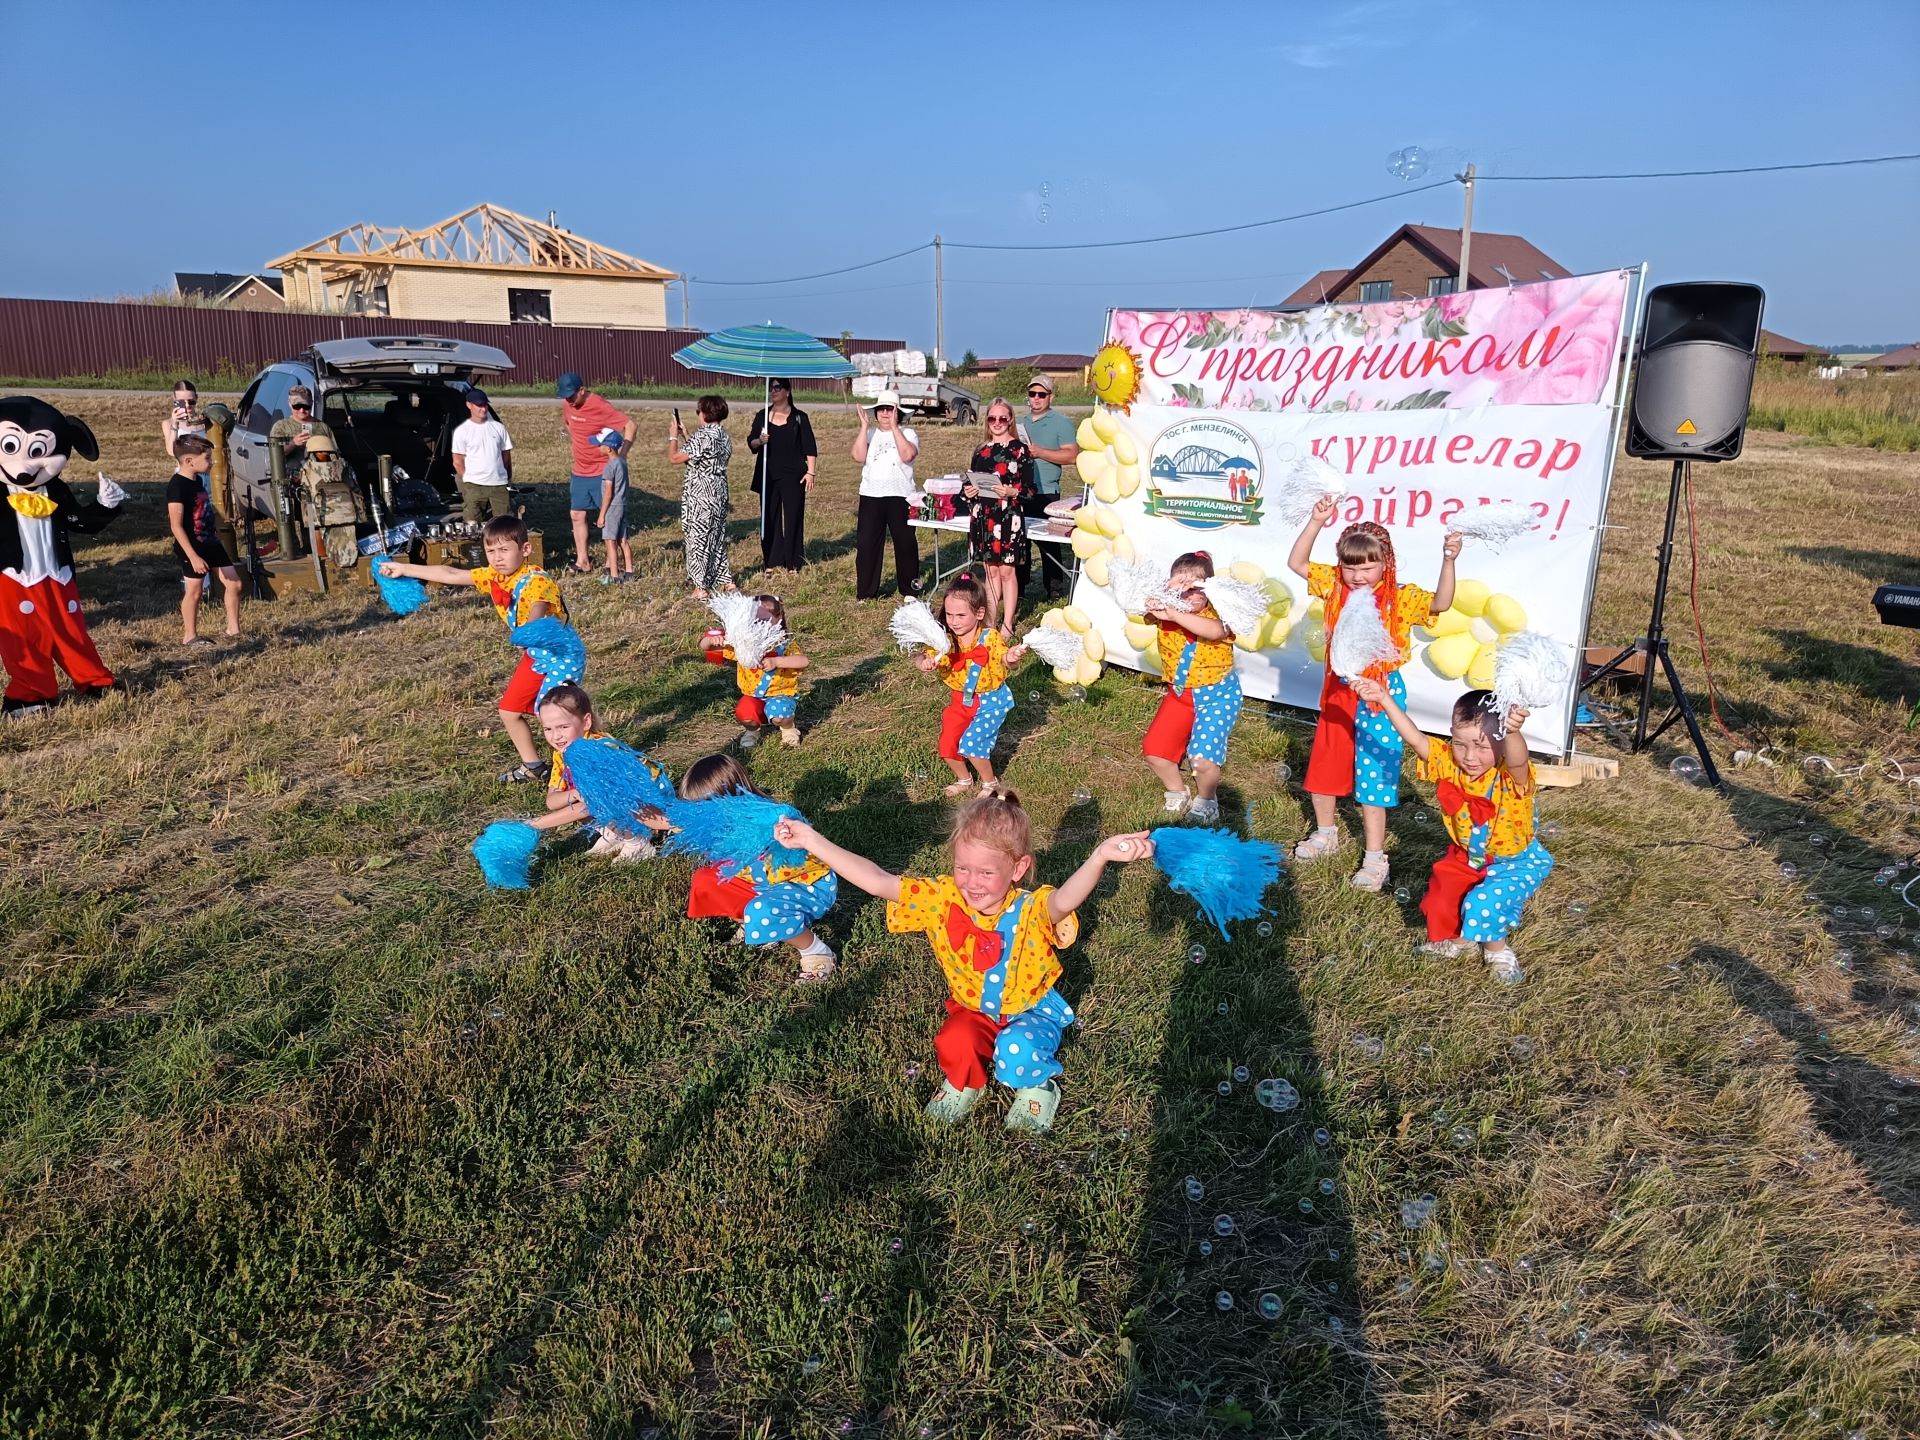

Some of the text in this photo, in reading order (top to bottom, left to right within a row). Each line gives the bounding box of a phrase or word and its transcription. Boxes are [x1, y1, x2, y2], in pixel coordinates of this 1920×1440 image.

[1139, 316, 1575, 409] С праздником
[1164, 428, 1181, 440] ТОС
[1190, 424, 1249, 445] МЕНЗЕЛИНСК
[1165, 499, 1244, 513] ТЕРРИТОРИАЛЬНОЕ
[1894, 594, 1920, 606] YAMAH
